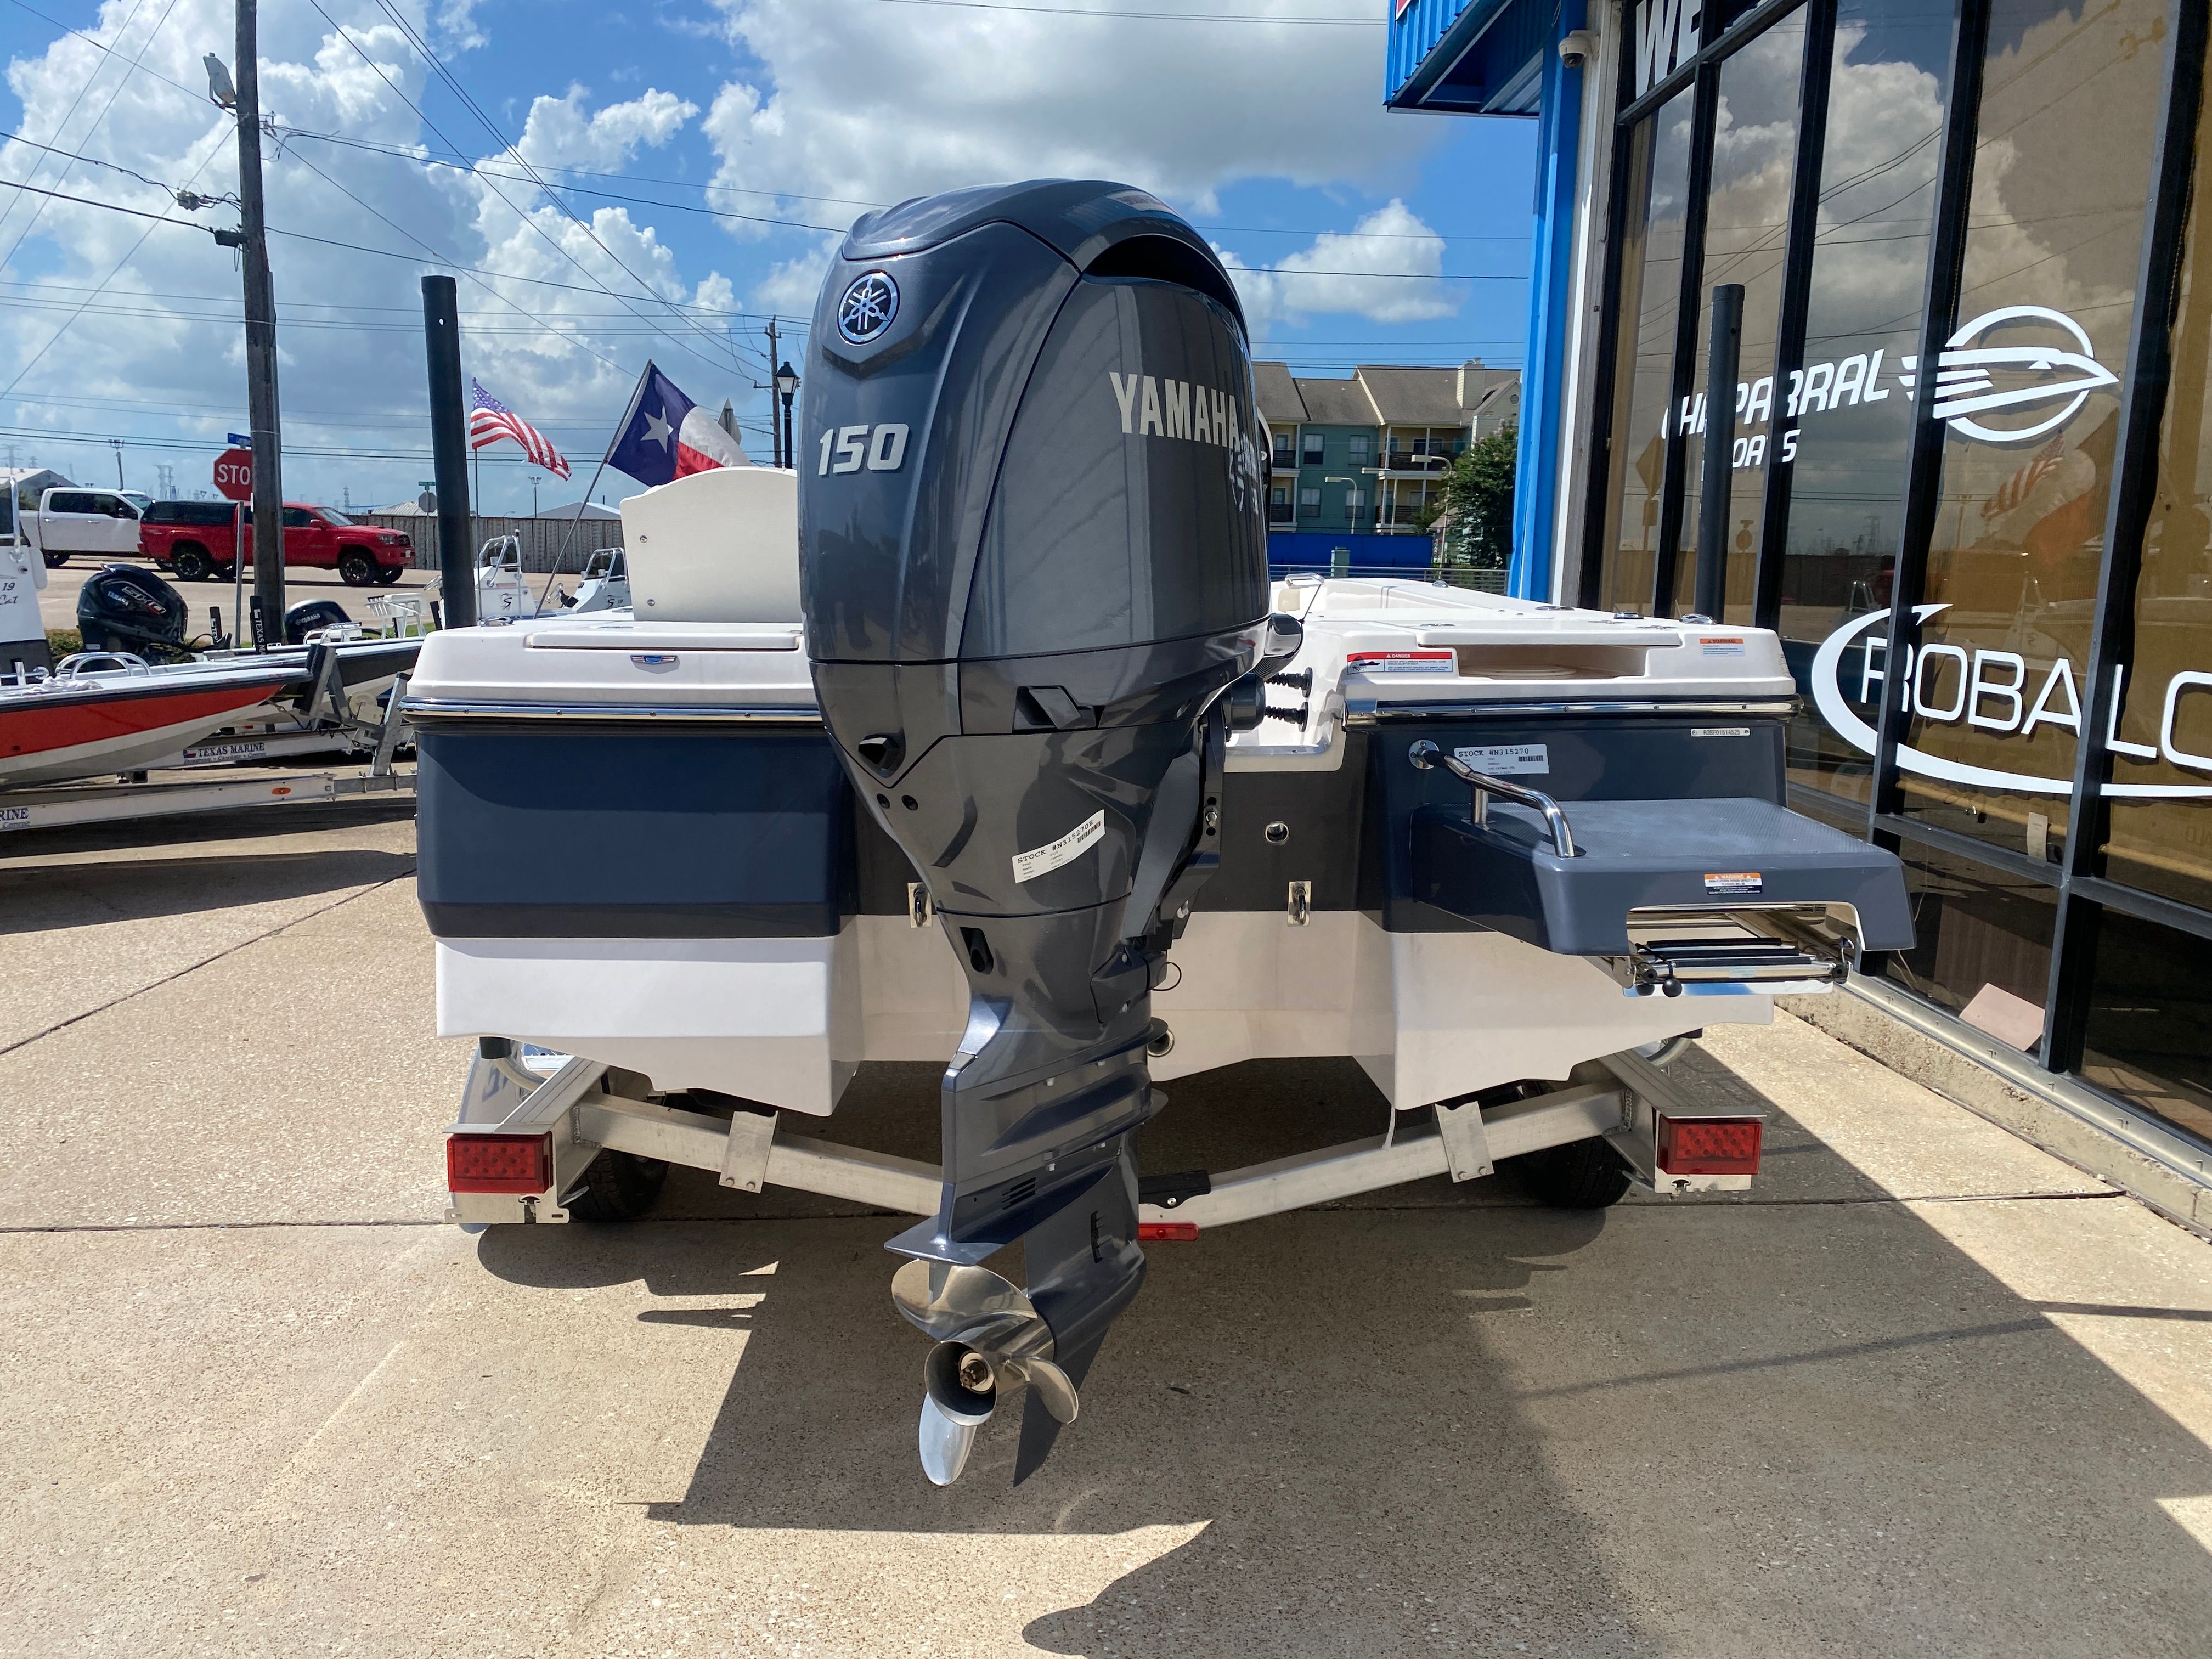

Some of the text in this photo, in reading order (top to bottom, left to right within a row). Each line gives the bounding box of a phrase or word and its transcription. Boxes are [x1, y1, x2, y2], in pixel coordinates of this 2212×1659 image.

[1109, 371, 1240, 452] YAMAHA
[818, 423, 909, 476] 150
[217, 464, 251, 486] STO
[3, 582, 15, 590] 19
[255, 619, 264, 642] TEXAS
[198, 746, 228, 757] TEXAS
[1018, 849, 1046, 864] STOCK
[1052, 820, 1093, 851] #N315270E
